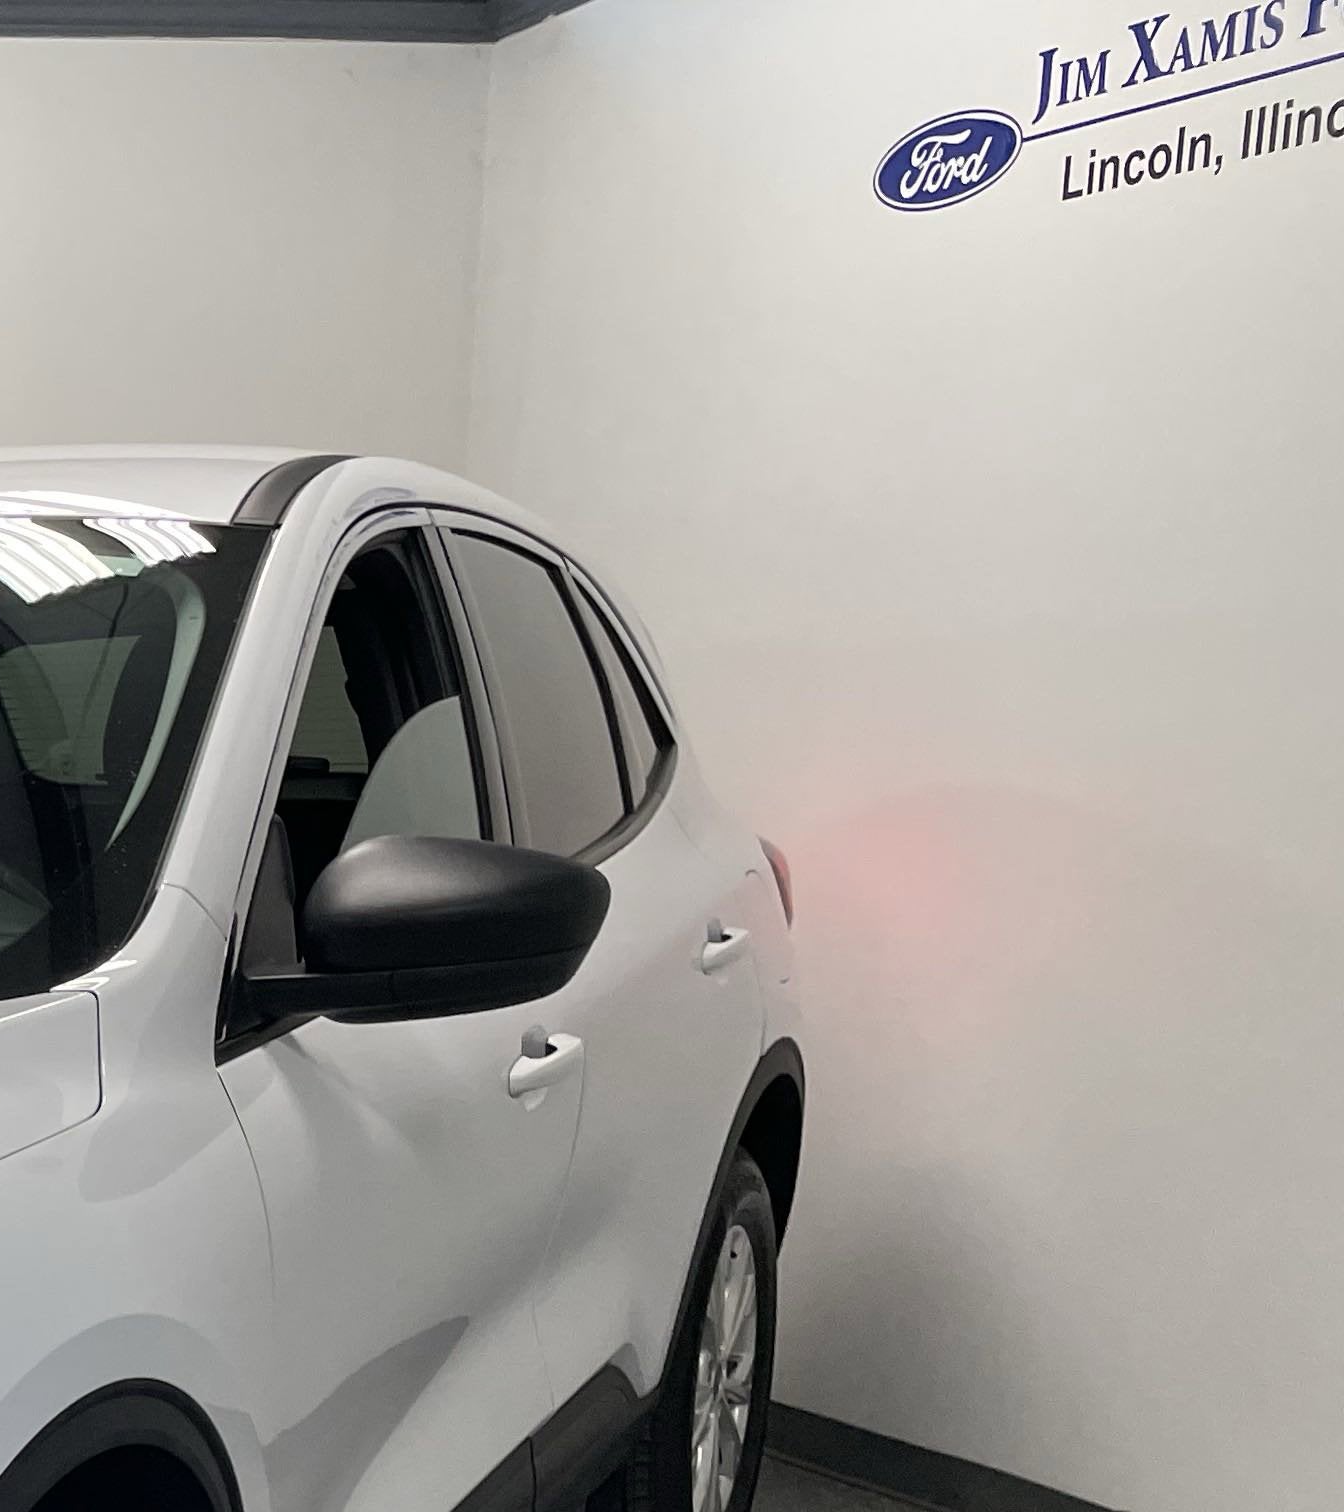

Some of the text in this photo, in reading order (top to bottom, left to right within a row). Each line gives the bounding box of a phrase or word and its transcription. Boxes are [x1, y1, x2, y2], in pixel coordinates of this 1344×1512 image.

[1030, 48, 1111, 125] JIM
[1122, 0, 1285, 88] XAMIS
[899, 128, 993, 199] Ford
[1062, 126, 1223, 201] Lincoln,
